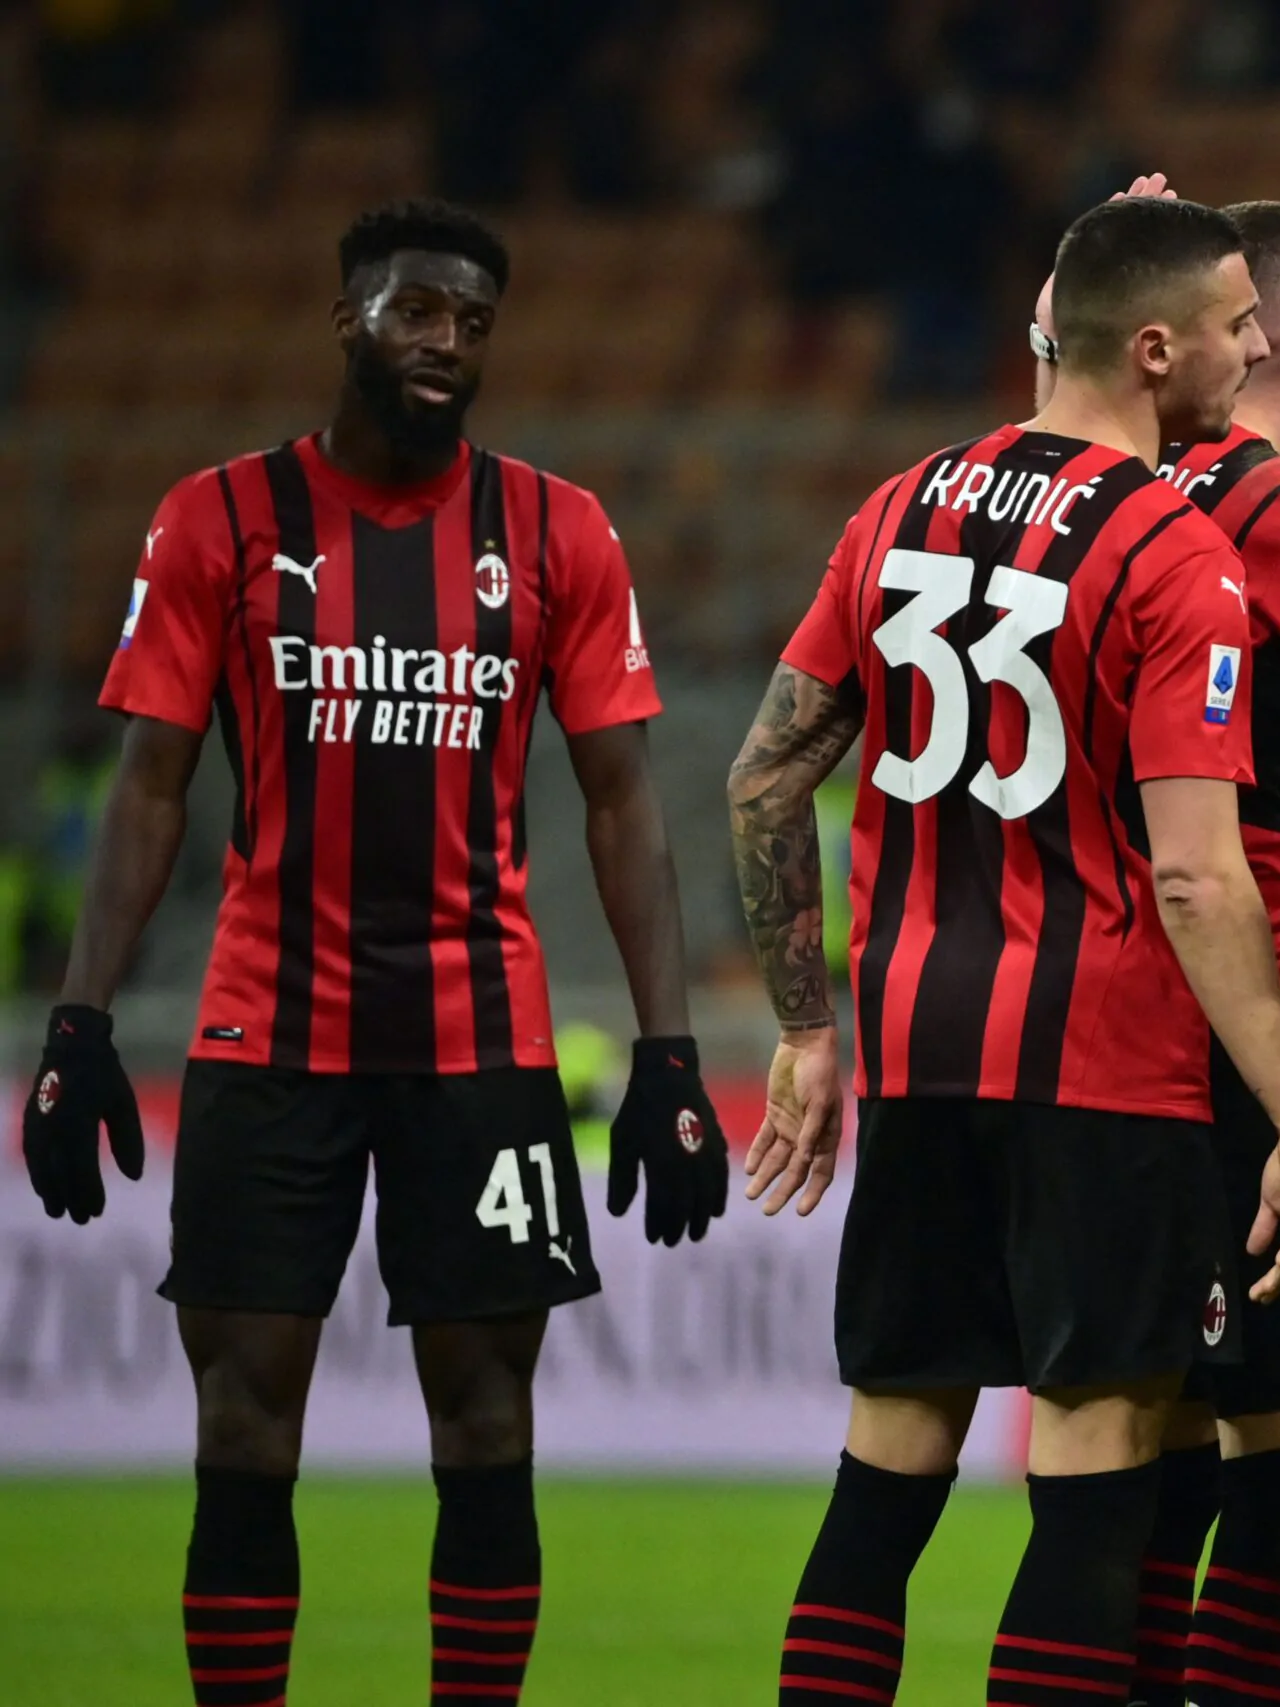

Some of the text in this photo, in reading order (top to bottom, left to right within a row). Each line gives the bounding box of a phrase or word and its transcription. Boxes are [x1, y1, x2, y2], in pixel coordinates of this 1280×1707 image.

[921, 459, 1103, 536] KRUNIĆ
[268, 635, 519, 700] Emirates
[871, 547, 1069, 820] 33
[308, 699, 484, 750] FLY BETTER
[475, 1142, 559, 1244] 41
